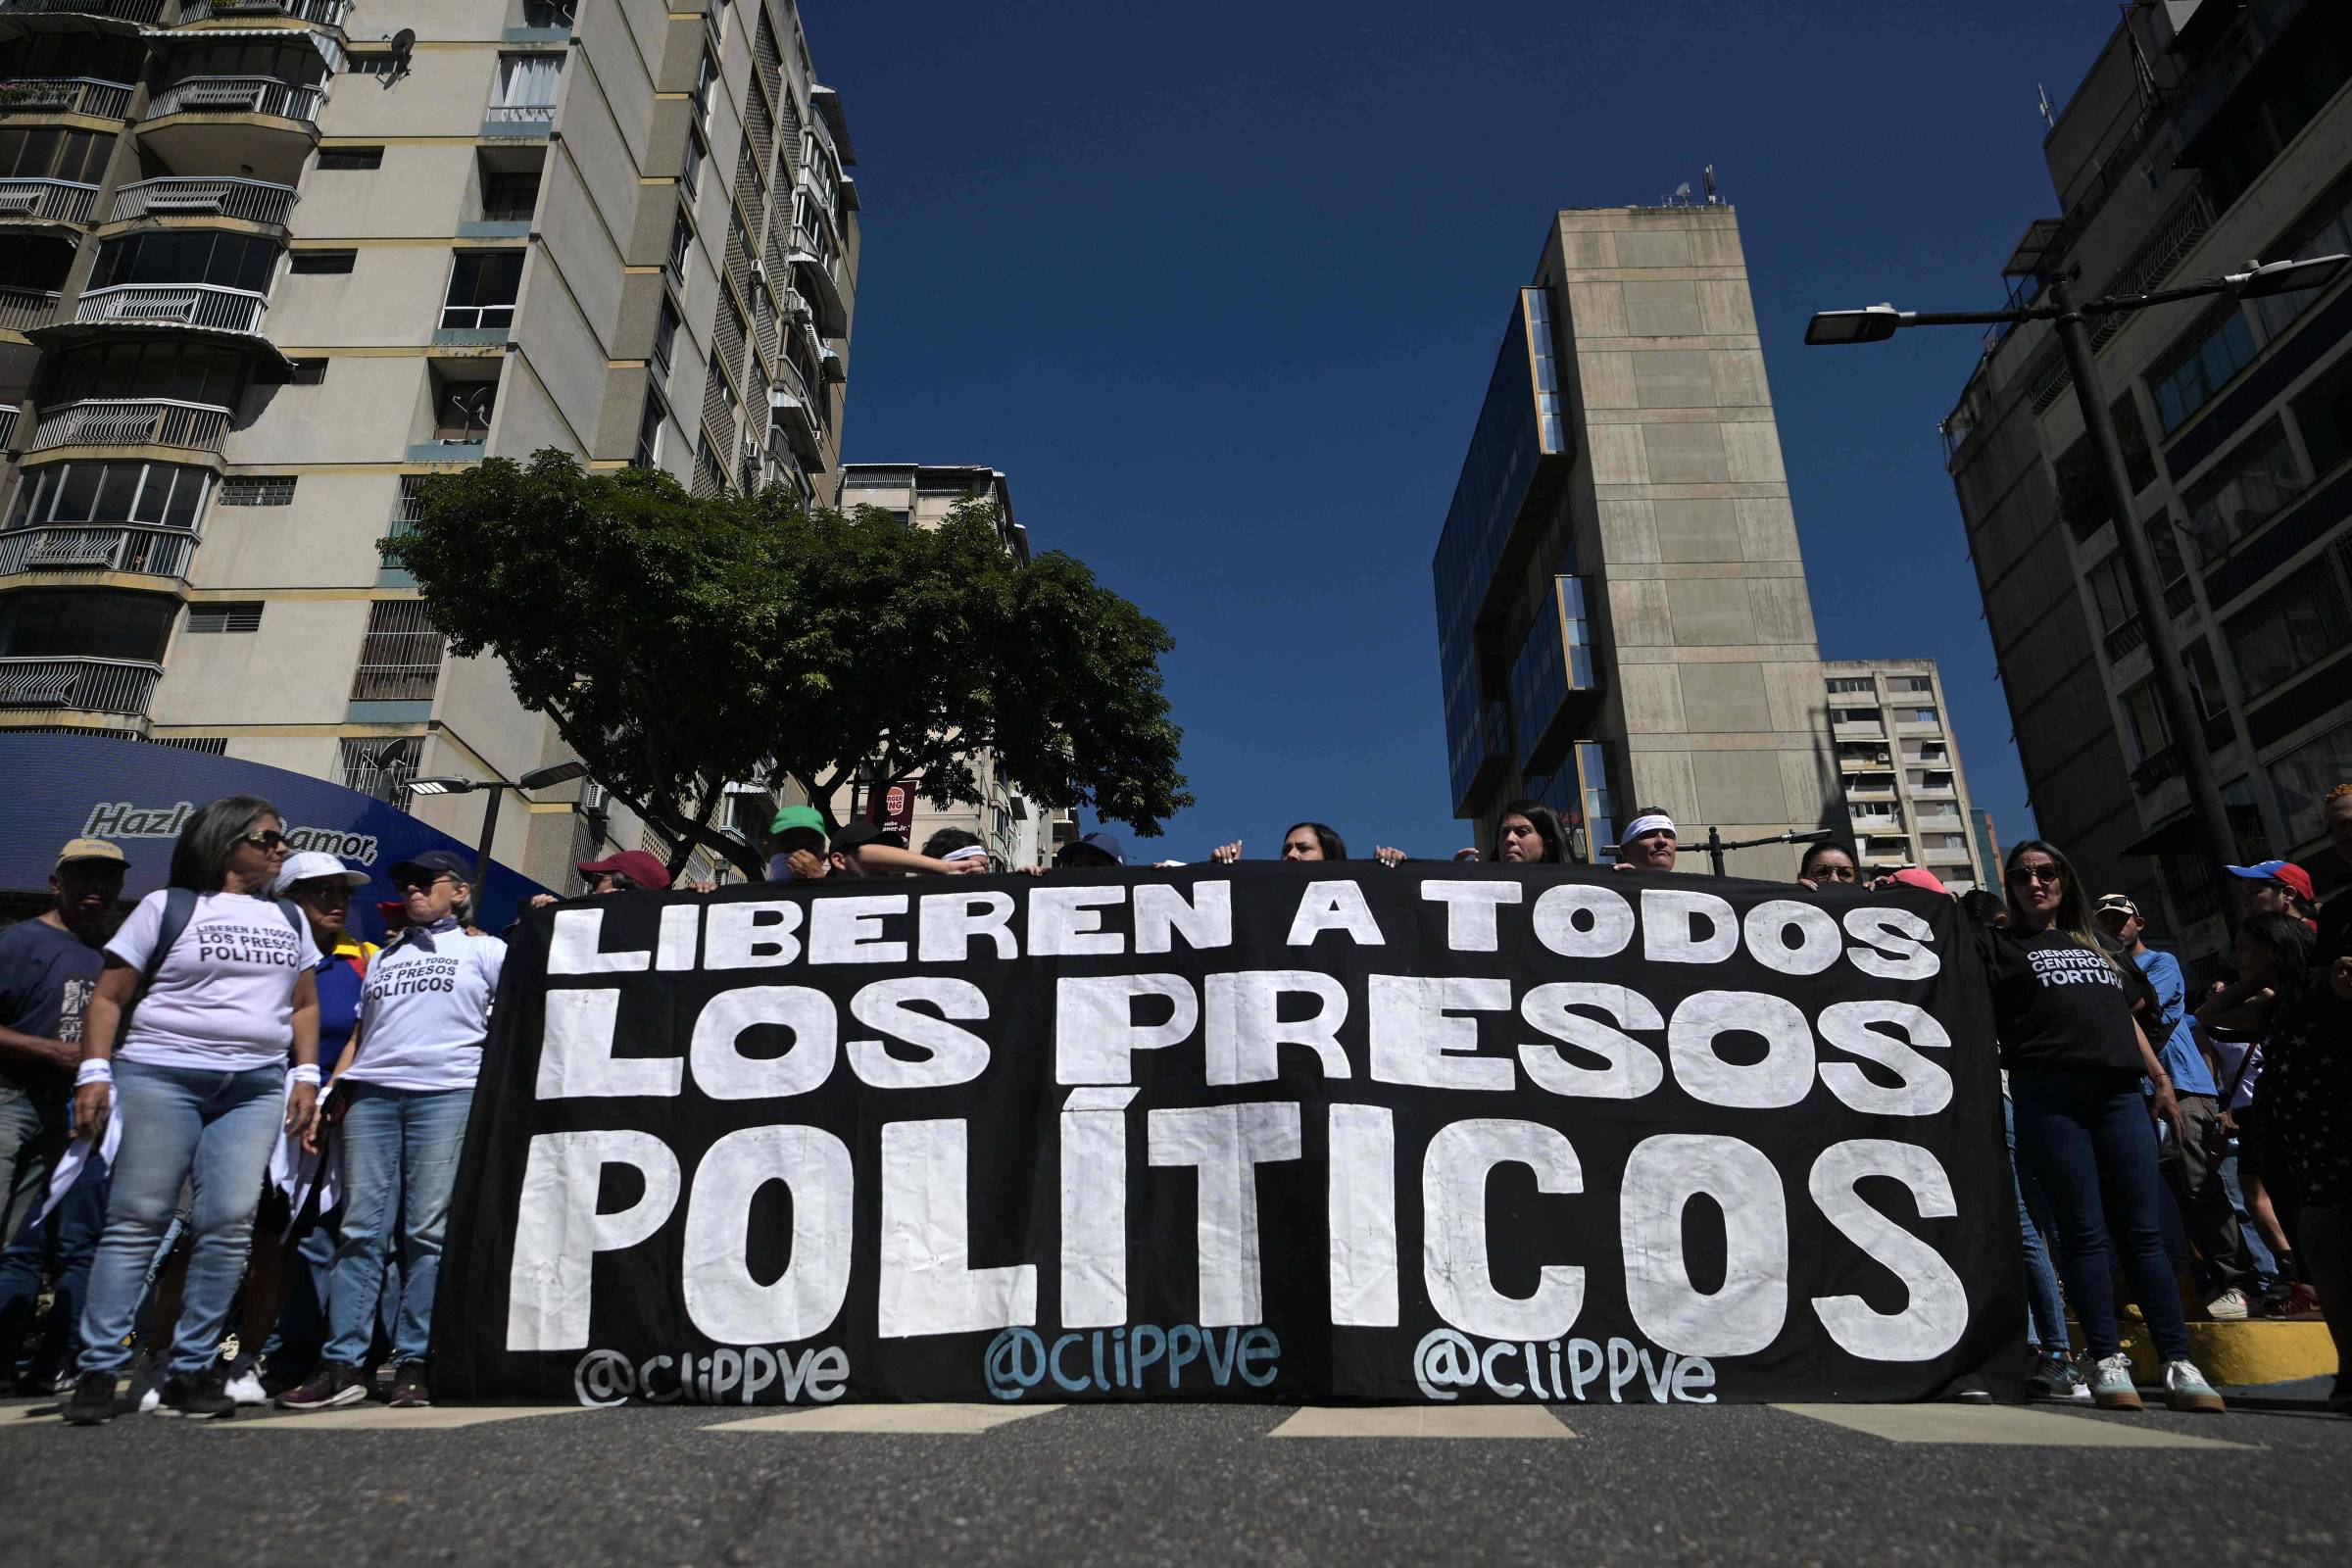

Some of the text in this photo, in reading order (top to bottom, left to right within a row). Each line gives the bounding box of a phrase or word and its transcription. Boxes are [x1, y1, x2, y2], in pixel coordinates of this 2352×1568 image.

[85, 804, 374, 862] Hazl amor,
[197, 925, 249, 934] LIBEREN
[200, 934, 234, 944] LOS
[547, 880, 1940, 980] LIBEREN A TODOS
[200, 947, 297, 967] POLÍTICO
[2028, 949, 2101, 960] CIERREN
[2032, 957, 2110, 972] CENTROS
[398, 965, 456, 979] PRESOS
[367, 977, 454, 1001] POLÍTICOS
[535, 969, 1953, 1116] LOS PRESOS
[507, 1086, 1969, 1361] POLÍTICOS
